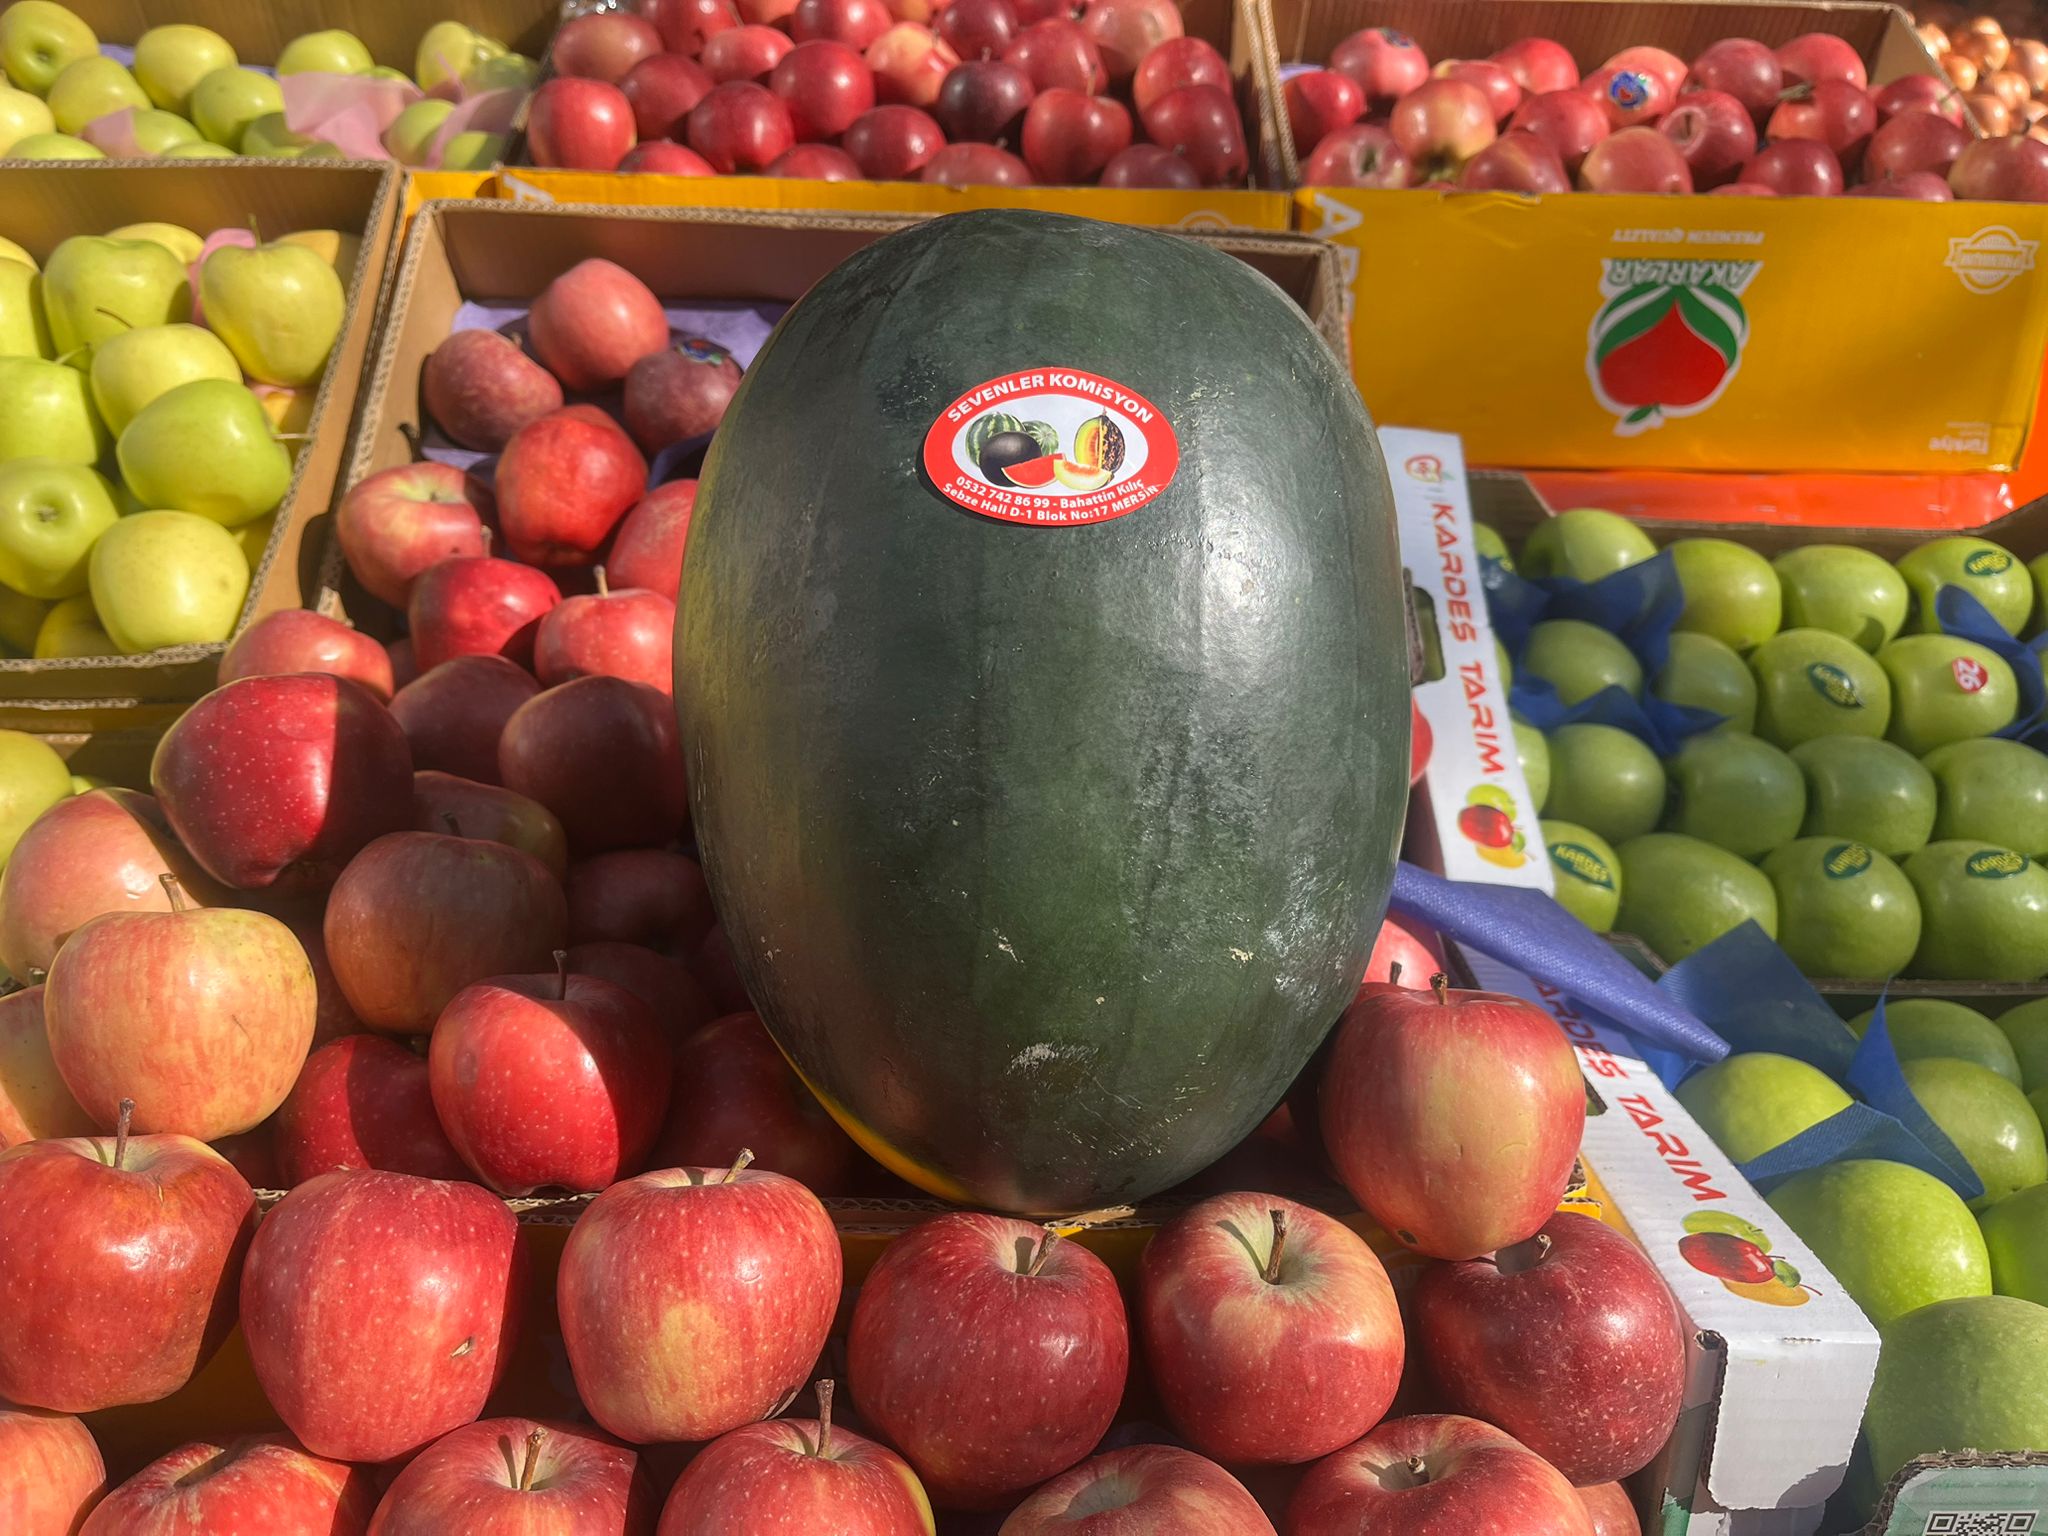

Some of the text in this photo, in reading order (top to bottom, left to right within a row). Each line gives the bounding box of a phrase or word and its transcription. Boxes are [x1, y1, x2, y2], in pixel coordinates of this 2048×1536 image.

[947, 374, 1045, 422] SEVENLER
[943, 483, 979, 506] Sebze
[980, 499, 1007, 515] Hali
[1009, 507, 1032, 519] D-1
[1037, 510, 1067, 521] Blok
[1070, 505, 1108, 520] No:17
[956, 476, 987, 496] 0532
[988, 489, 1012, 504] 742
[1014, 496, 1031, 507] 86
[1033, 497, 1050, 508] 99
[1060, 491, 1116, 508] Bahattin
[1116, 479, 1145, 496] Kılıç
[1957, 658, 1981, 690] 26
[1458, 659, 1505, 775] TARIM
[1530, 975, 1727, 1202] ARDEŞ TARIM
